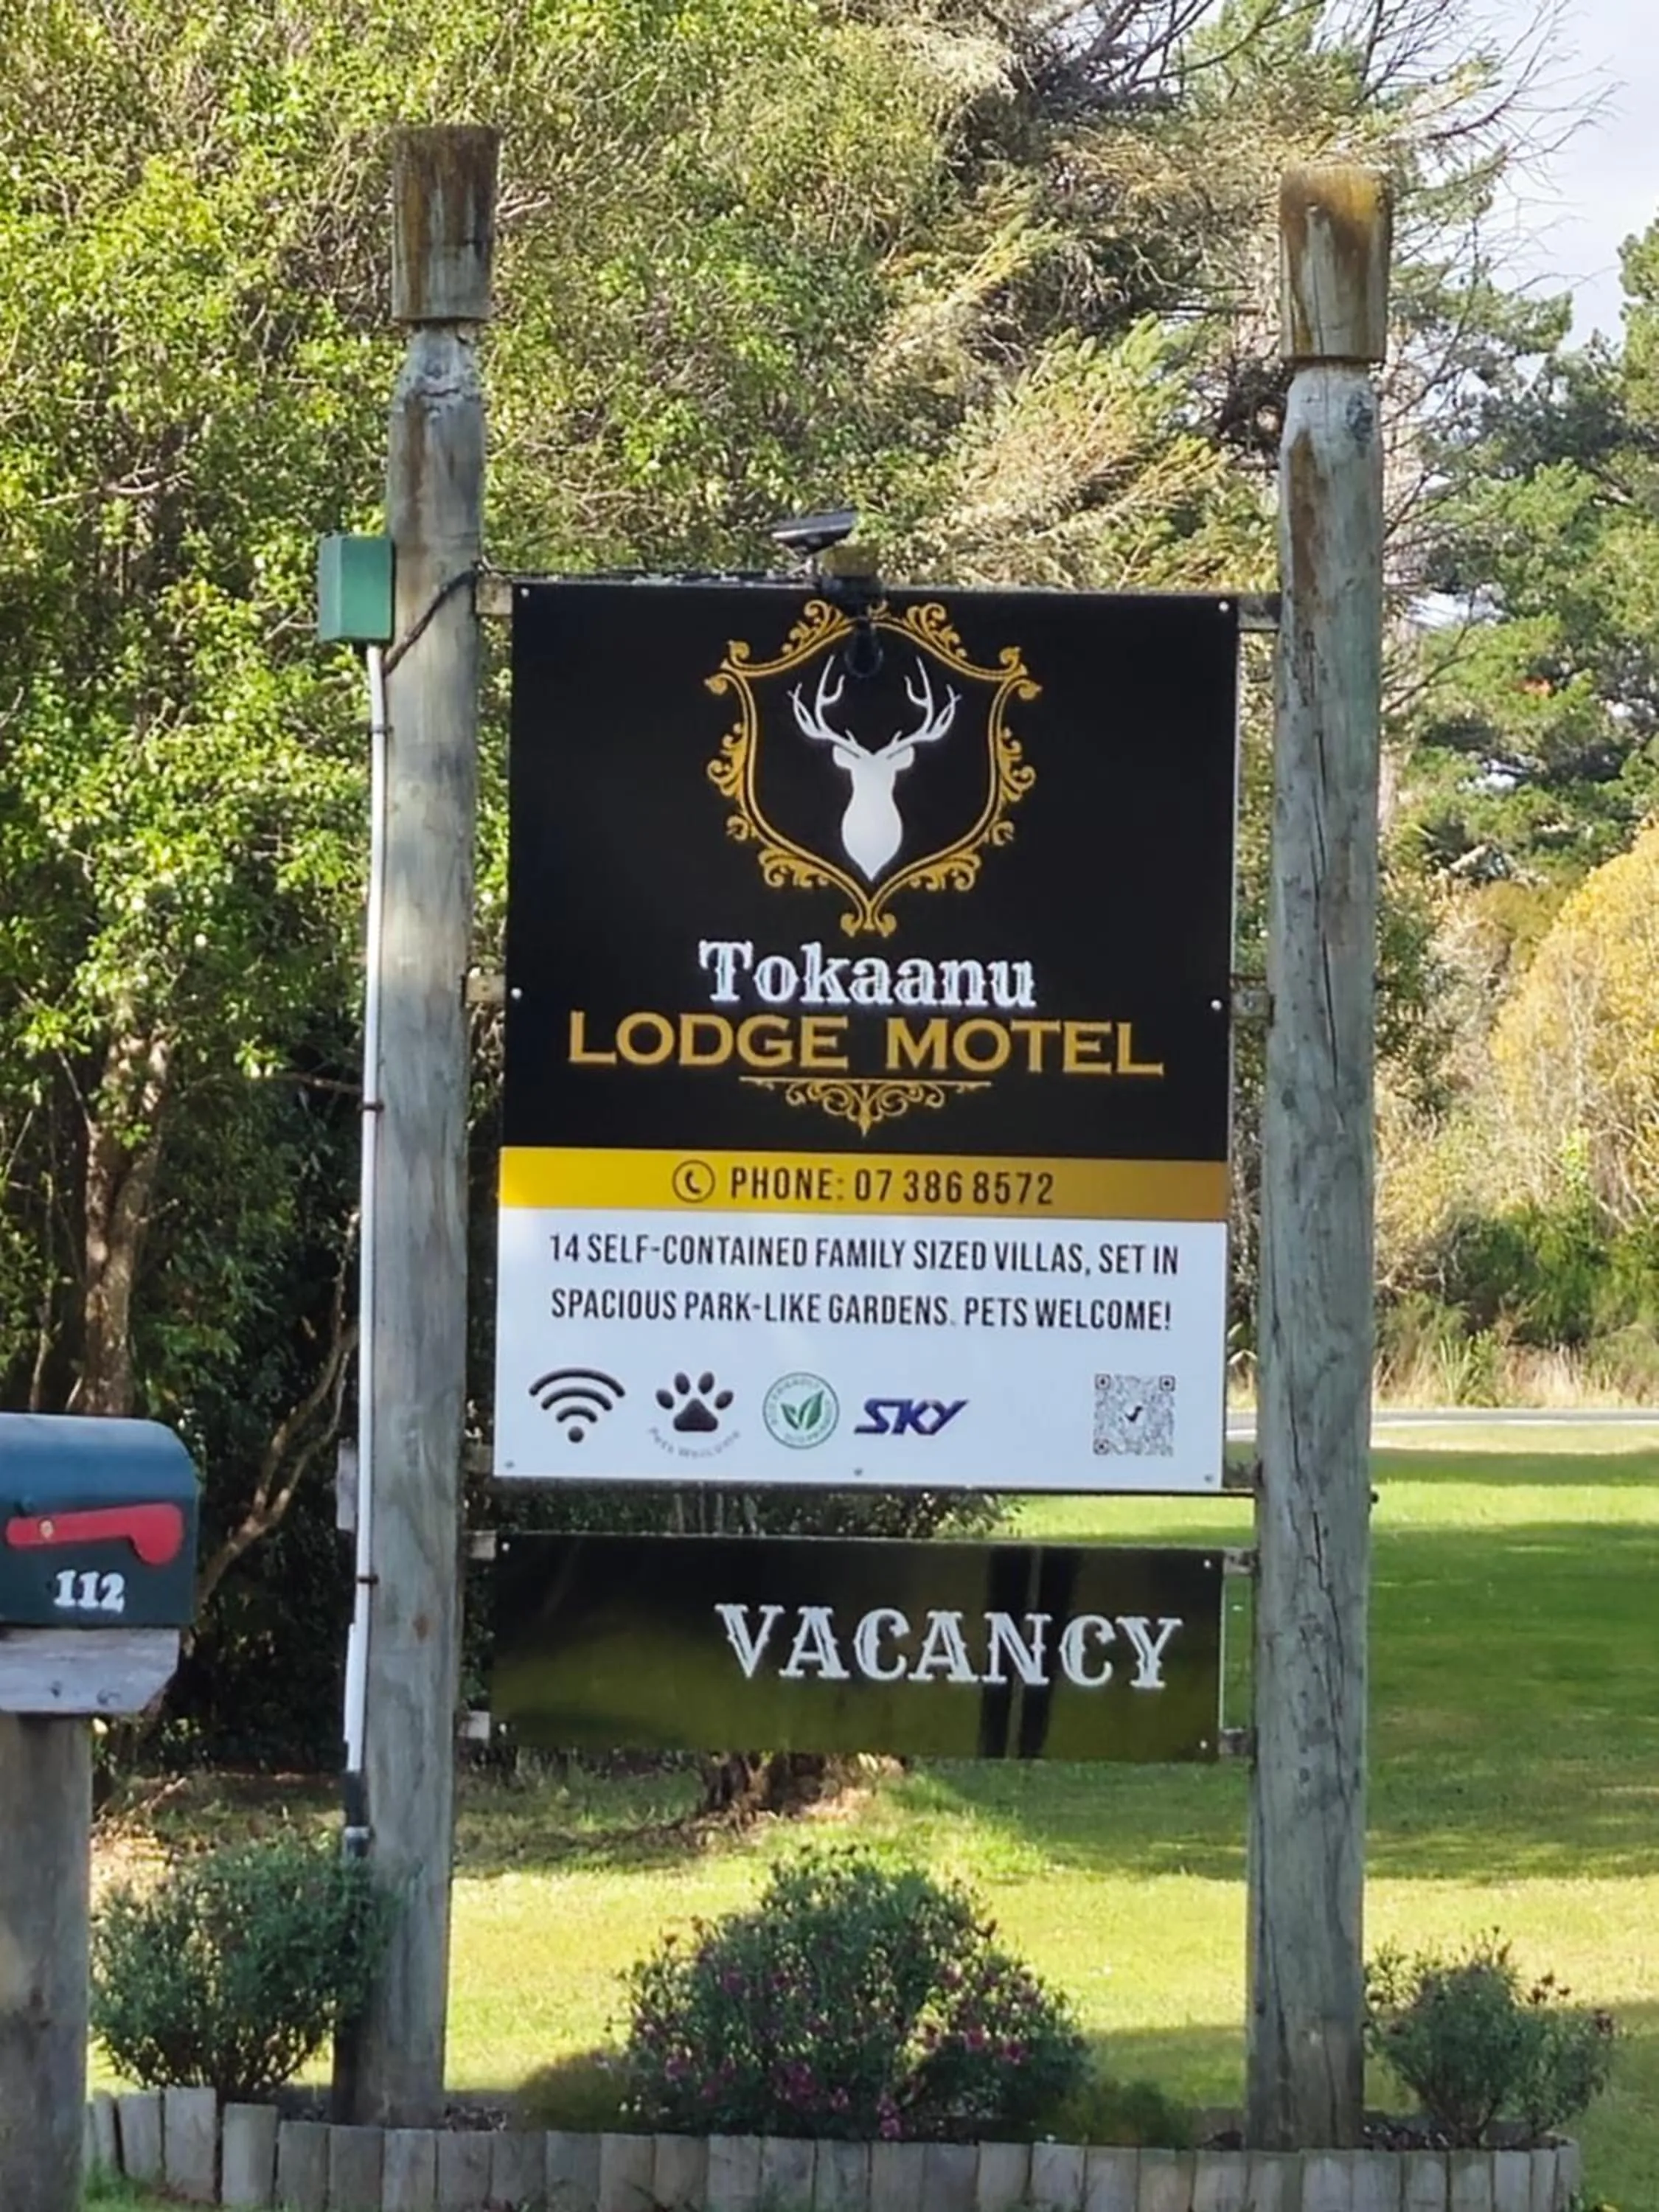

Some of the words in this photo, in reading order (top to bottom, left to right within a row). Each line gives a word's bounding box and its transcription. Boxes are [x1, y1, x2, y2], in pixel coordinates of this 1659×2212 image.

[698, 939, 1037, 1008] Tokaanu
[569, 1011, 849, 1069] LODGE
[886, 1018, 1164, 1076] MOTEL
[731, 1166, 844, 1200] PHONE:
[855, 1169, 892, 1202] 07
[903, 1170, 963, 1204] 386
[973, 1171, 1053, 1206] 8572
[551, 1234, 579, 1262] 14
[588, 1234, 807, 1267] SELF-CONTAINED
[816, 1238, 905, 1268] FAMILY
[914, 1240, 987, 1270] SIZED
[995, 1242, 1091, 1276] VILLAS,
[1099, 1244, 1145, 1274] SET
[1154, 1245, 1178, 1274] IN
[552, 1289, 676, 1321] SPACIOUS
[684, 1291, 821, 1323] PARK-LIKE
[964, 1297, 1027, 1327] PETS
[1035, 1299, 1170, 1330] WELCOME!
[854, 1399, 967, 1436] SKY
[54, 1569, 125, 1613] 112
[714, 1604, 1183, 1688] VACANCY
